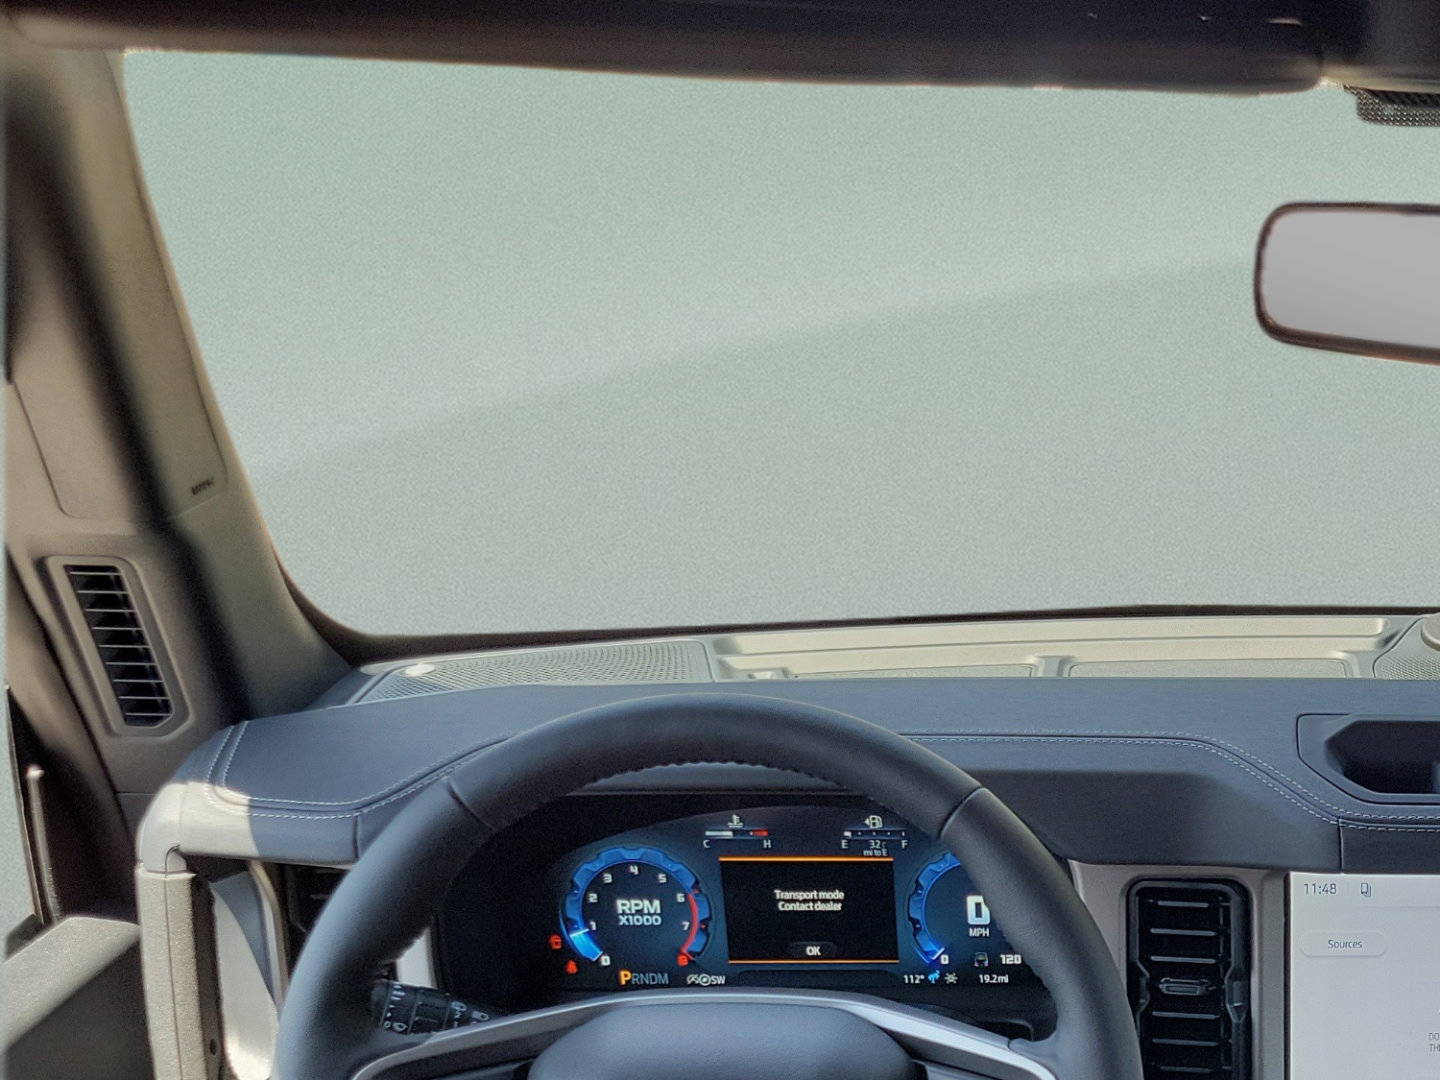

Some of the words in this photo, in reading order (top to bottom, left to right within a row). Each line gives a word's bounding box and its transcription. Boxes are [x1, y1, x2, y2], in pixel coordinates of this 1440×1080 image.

[703, 839, 710, 848] C
[764, 839, 771, 848] H
[842, 839, 848, 848] E
[901, 839, 908, 848] F
[629, 865, 639, 875] 4
[603, 873, 613, 883] 3
[658, 873, 667, 883] 5
[1303, 882, 1337, 895] 11:48
[588, 893, 598, 903] 2
[676, 893, 685, 903] 6
[774, 889, 818, 901] Transport
[818, 890, 845, 900] mode
[616, 899, 661, 914] RPM
[778, 901, 814, 911] Contact
[814, 901, 843, 911] dealer
[590, 921, 597, 930] 1
[618, 915, 662, 926] X1000
[682, 921, 690, 930] 7
[968, 928, 990, 937] MPH
[1327, 939, 1363, 949] Sources
[806, 946, 821, 956] OK
[600, 955, 611, 966] 0
[940, 954, 949, 964] 0
[1000, 954, 1022, 964] 120
[711, 975, 726, 985] SW
[903, 974, 925, 984] 112°
[1428, 1032, 1440, 1041] DO
